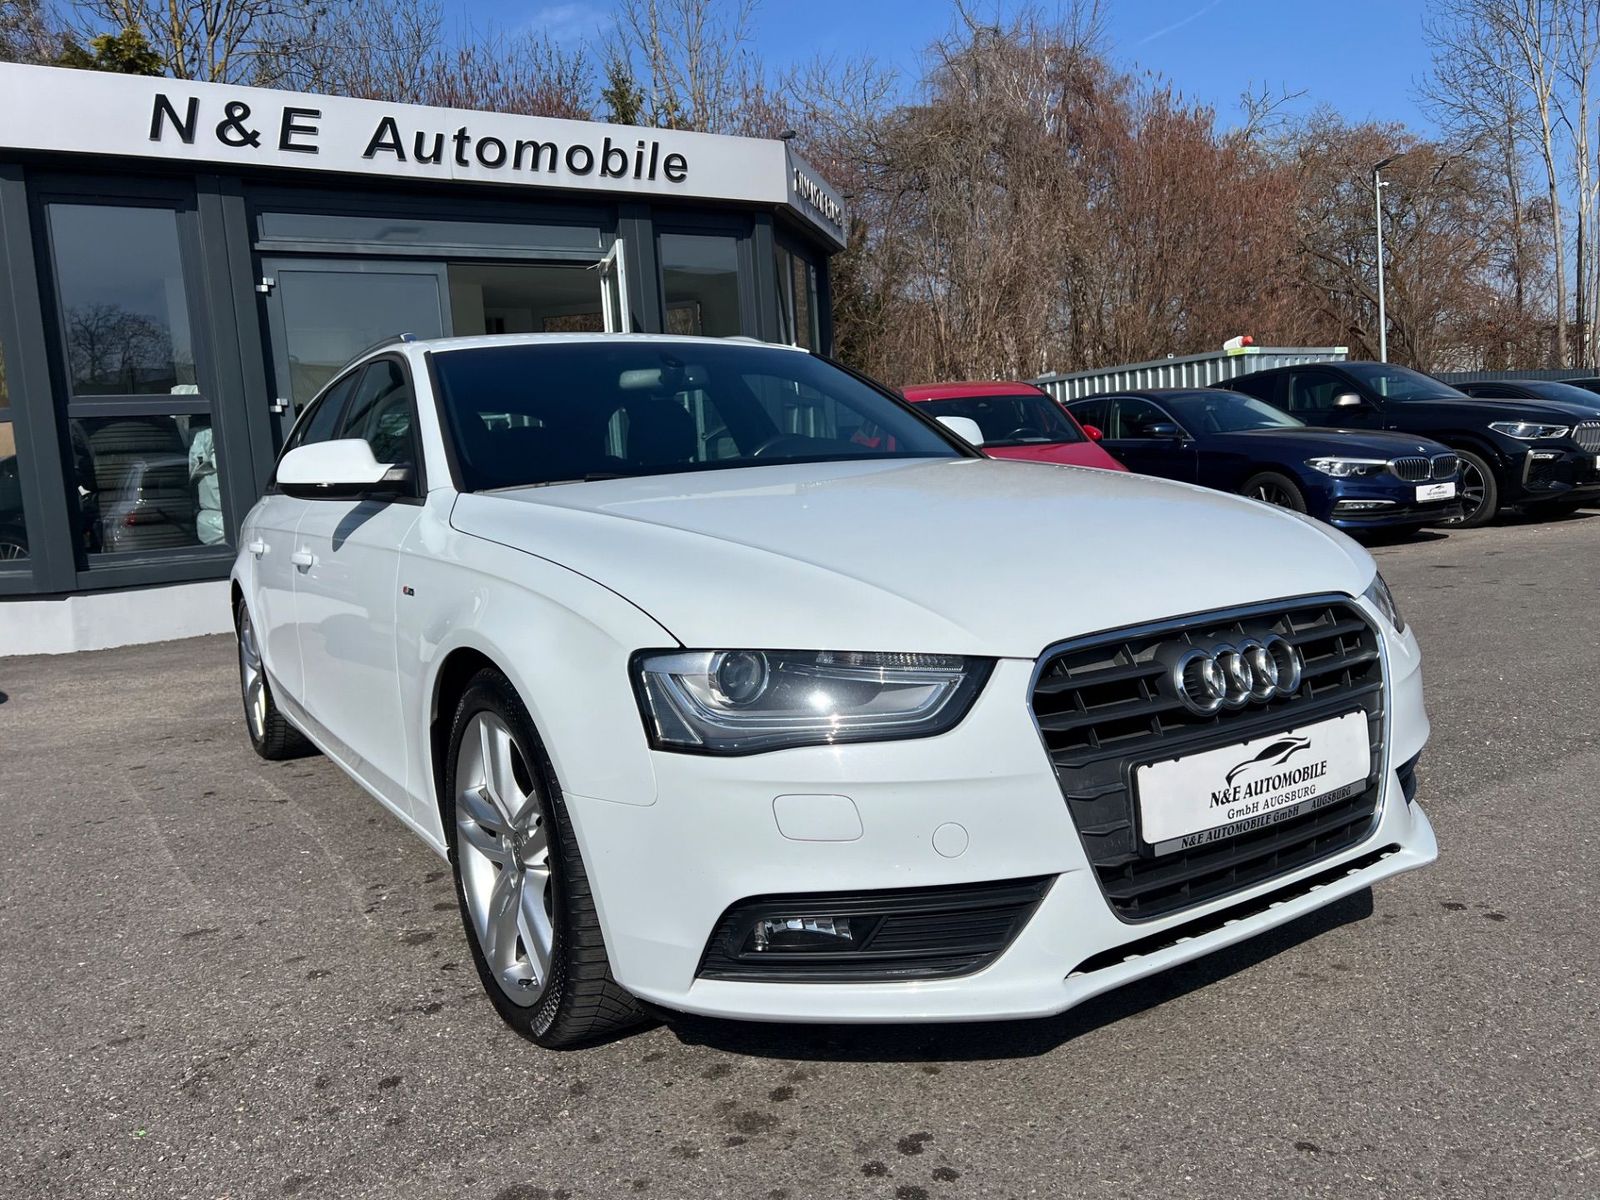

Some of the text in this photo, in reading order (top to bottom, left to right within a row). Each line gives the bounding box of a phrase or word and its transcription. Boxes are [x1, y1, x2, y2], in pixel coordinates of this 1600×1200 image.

[361, 116, 689, 183] Automobile
[1209, 760, 1328, 808] N&E AUTOMOBILE
[1227, 784, 1317, 820] GmbH AUGSBURG
[1181, 786, 1352, 849] N&E AUTOMOBILE GmbH AUGSBURG
